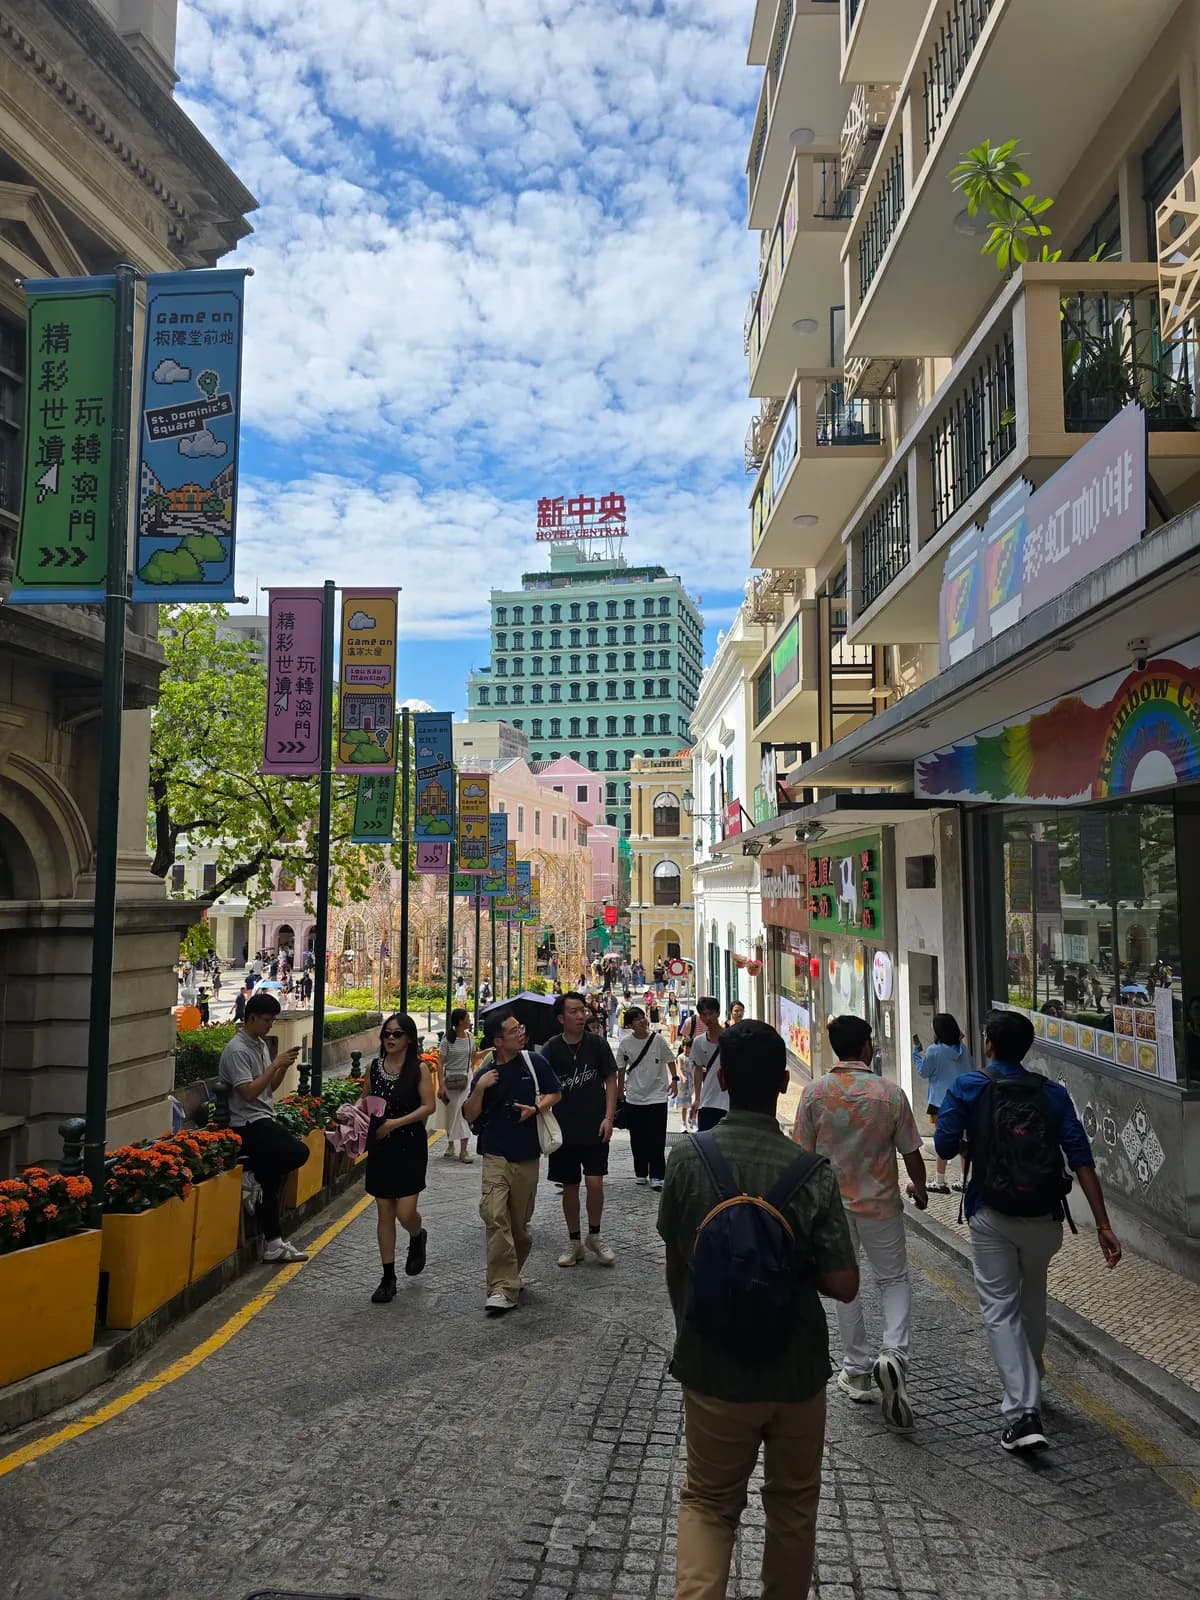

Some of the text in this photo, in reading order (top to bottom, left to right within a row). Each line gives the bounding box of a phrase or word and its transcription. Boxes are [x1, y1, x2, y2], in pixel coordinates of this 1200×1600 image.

[156, 311, 233, 324] Game on
[36, 321, 71, 467] 精彩世遺
[151, 401, 228, 425] St. Dominic's
[68, 398, 105, 542] 玩轉澳門
[536, 527, 626, 540] HOTEL CENTRAL
[537, 491, 626, 527] 新中央
[1022, 449, 1132, 583] 彩虹咖啡
[274, 612, 296, 695] 精彩世遺
[347, 638, 377, 646] Game
[295, 656, 316, 739] 玩轉澳門
